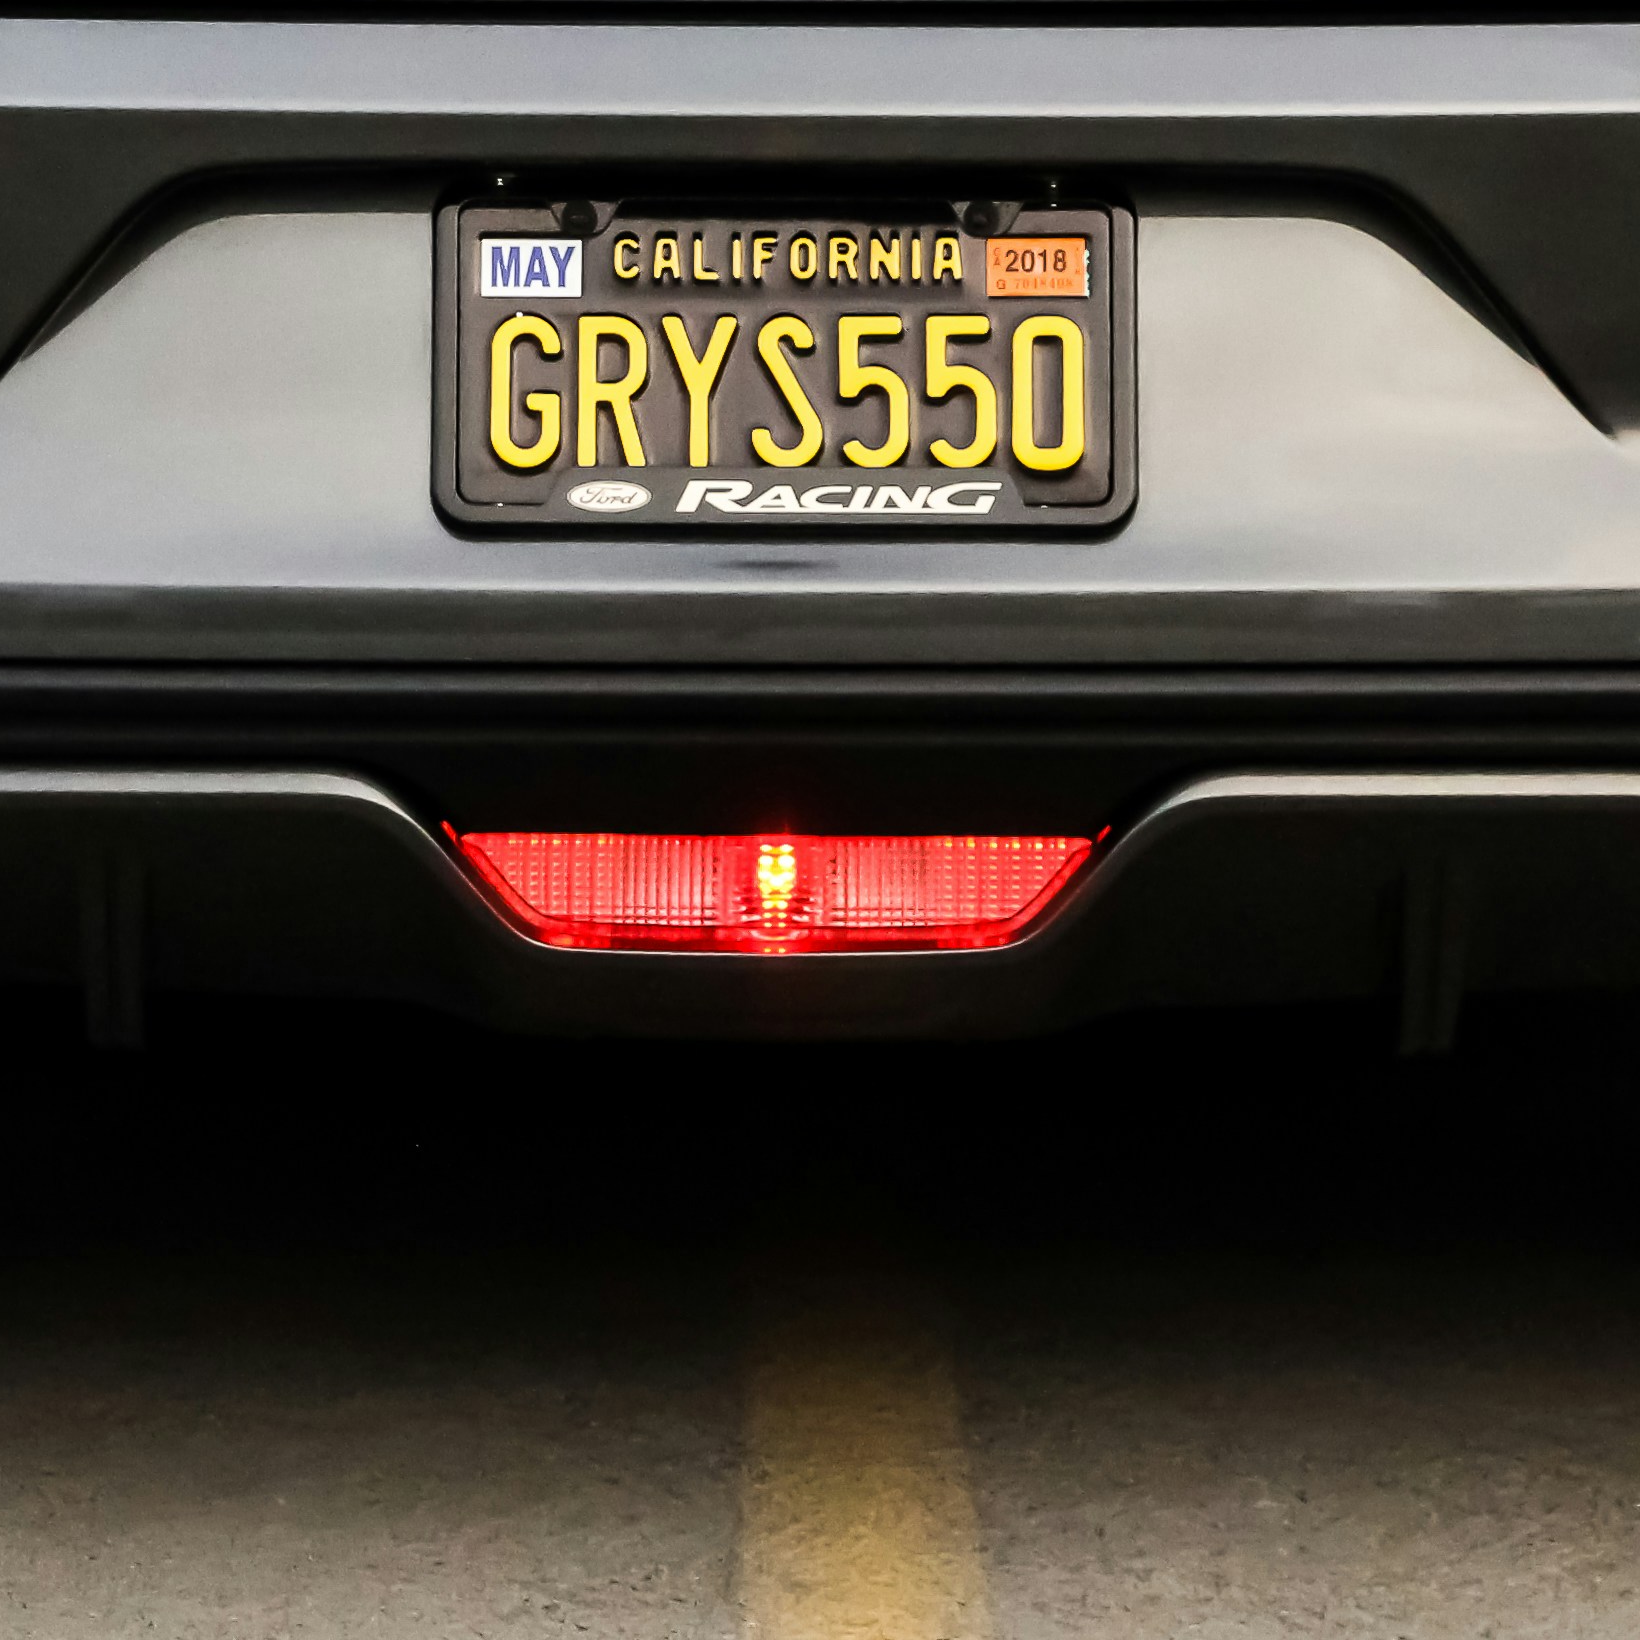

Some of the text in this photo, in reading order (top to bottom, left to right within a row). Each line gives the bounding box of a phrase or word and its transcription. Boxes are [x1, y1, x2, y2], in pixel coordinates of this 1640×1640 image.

[490, 245, 574, 288] MAY
[612, 236, 964, 281] CALIFORNIA
[1004, 248, 1068, 273] 2018
[488, 314, 1087, 472] GRYS550
[674, 479, 1003, 516] RACING
